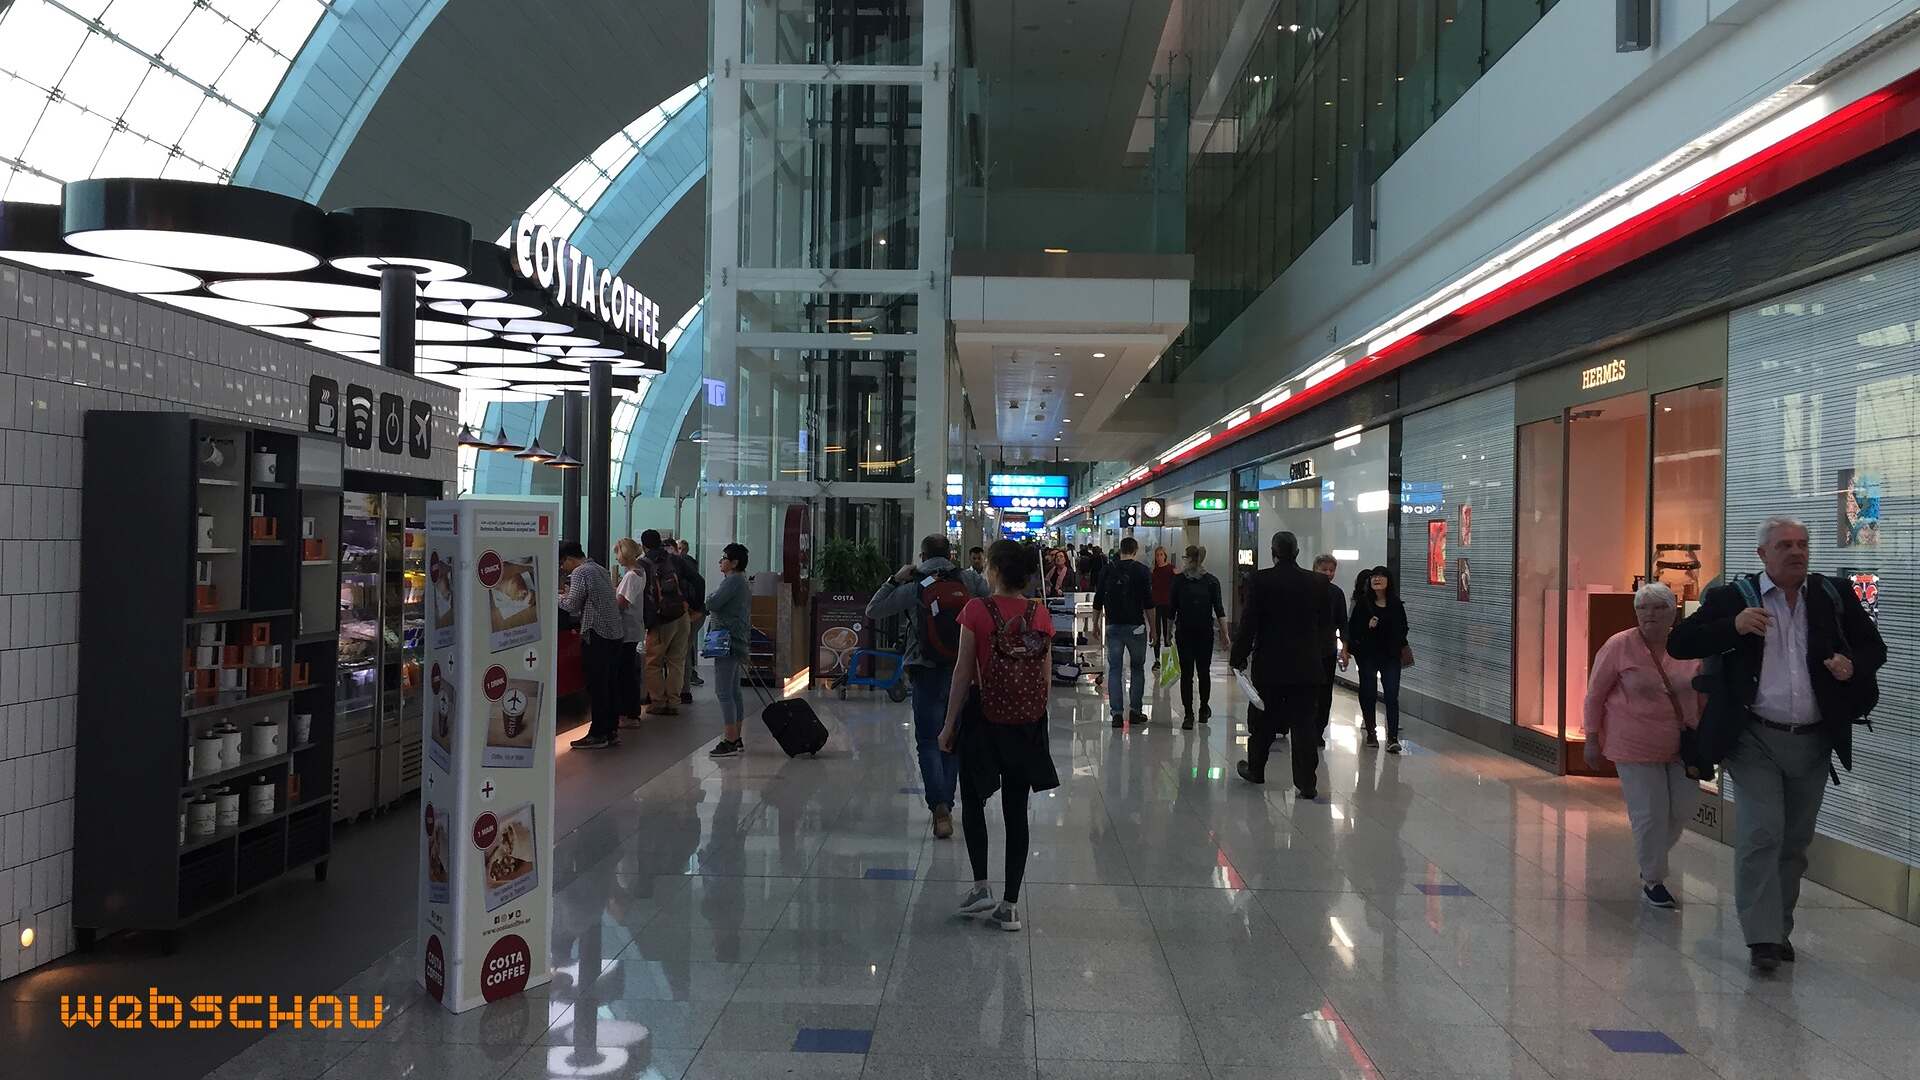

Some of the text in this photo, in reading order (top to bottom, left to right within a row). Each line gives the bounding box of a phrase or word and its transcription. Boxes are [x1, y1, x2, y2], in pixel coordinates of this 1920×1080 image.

[512, 212, 660, 350] COSTA COFFEE
[1582, 359, 1626, 390] HERMÈS
[489, 951, 523, 971] COSTA
[486, 964, 526, 987] COFFEE
